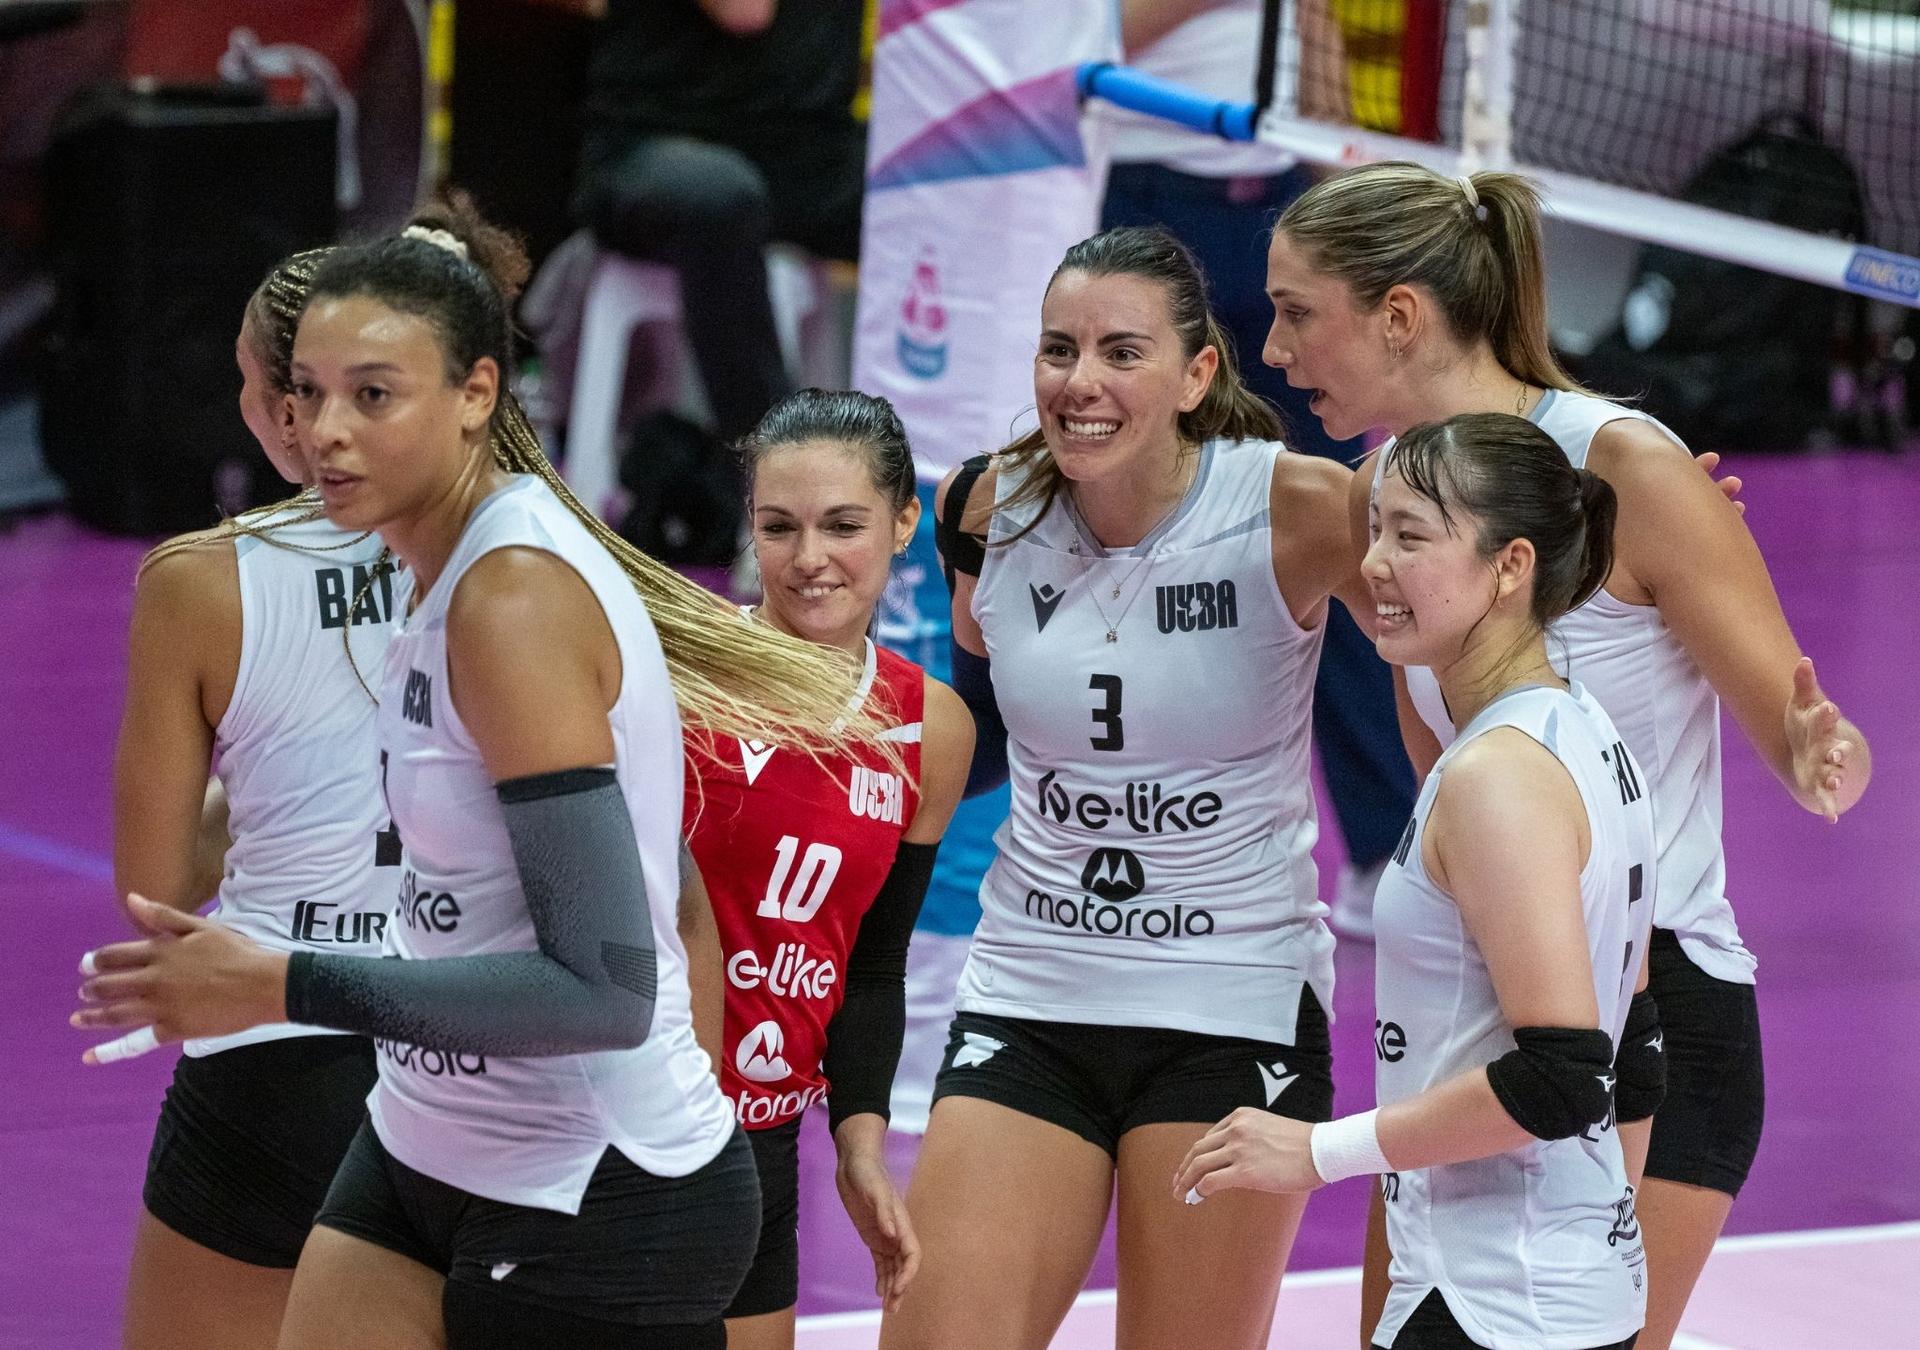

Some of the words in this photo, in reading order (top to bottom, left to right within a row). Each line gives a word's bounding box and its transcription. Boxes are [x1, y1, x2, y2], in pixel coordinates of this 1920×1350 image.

[315, 559, 401, 629] BAT
[1089, 673, 1125, 752] 3
[756, 834, 843, 923] 10
[1025, 888, 1215, 938] motorola
